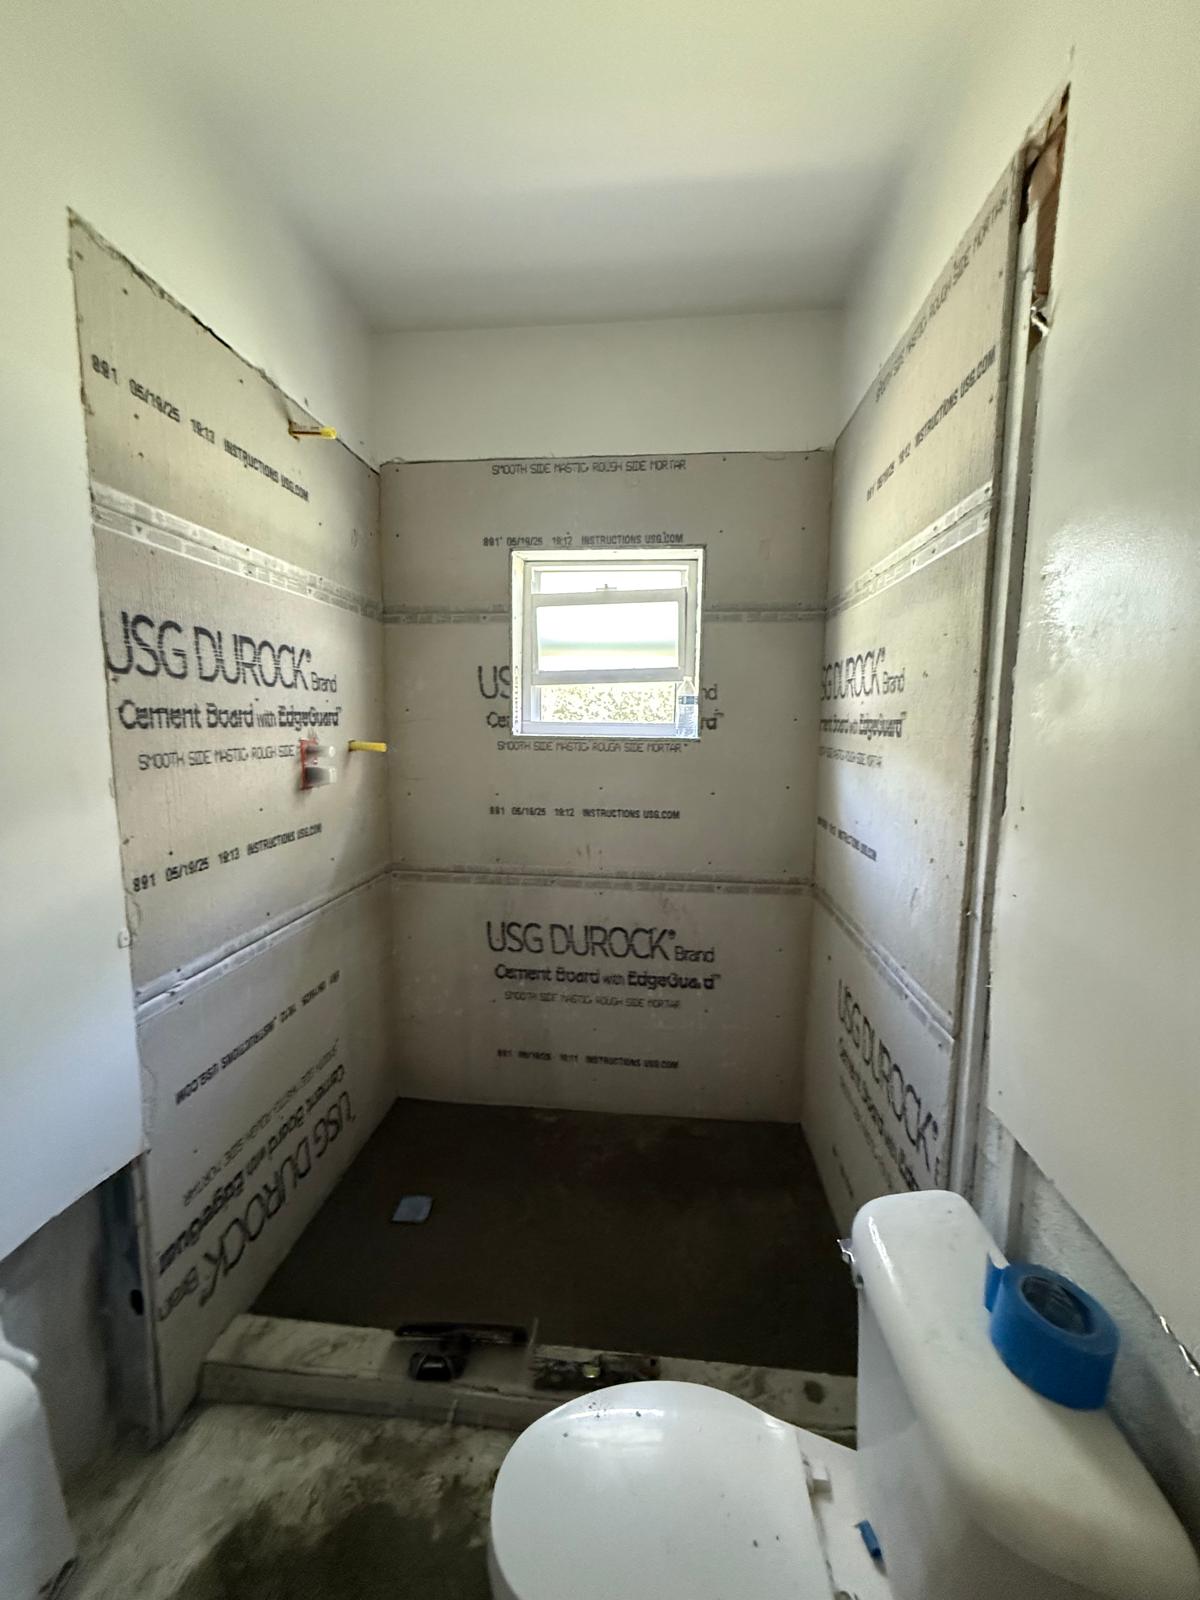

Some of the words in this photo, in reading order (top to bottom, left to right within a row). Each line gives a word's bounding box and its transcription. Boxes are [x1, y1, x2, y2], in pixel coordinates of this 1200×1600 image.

[224, 438, 279, 484] INSTRUCTIONS
[491, 463, 528, 475] SMOOTH
[530, 462, 551, 474] SIDE
[626, 459, 647, 472] SIDE
[649, 458, 687, 472] MORTAR
[581, 534, 642, 546] INSTRUCTIONS
[103, 611, 188, 679] USG
[311, 671, 337, 693] Brand
[477, 665, 512, 700] US
[118, 700, 202, 730] Cement
[206, 702, 254, 728] Board
[256, 710, 276, 728] with
[138, 753, 186, 771] SMOOTH
[189, 750, 212, 766] SIDE
[278, 744, 295, 758] SIDE
[533, 741, 553, 751] SIDE
[623, 742, 644, 753] SIDE
[582, 808, 640, 819] INSTRUCTIONS
[643, 809, 680, 819] USG.COM
[165, 857, 210, 882] 05/19/25
[246, 831, 296, 856] INSTRUCTIONS
[486, 920, 544, 954] USG
[675, 946, 715, 963] Brand
[494, 963, 552, 980] Cement
[556, 966, 600, 985] Board
[602, 974, 625, 986] with
[314, 1090, 356, 1159] USG
[158, 1265, 200, 1322] Bran
